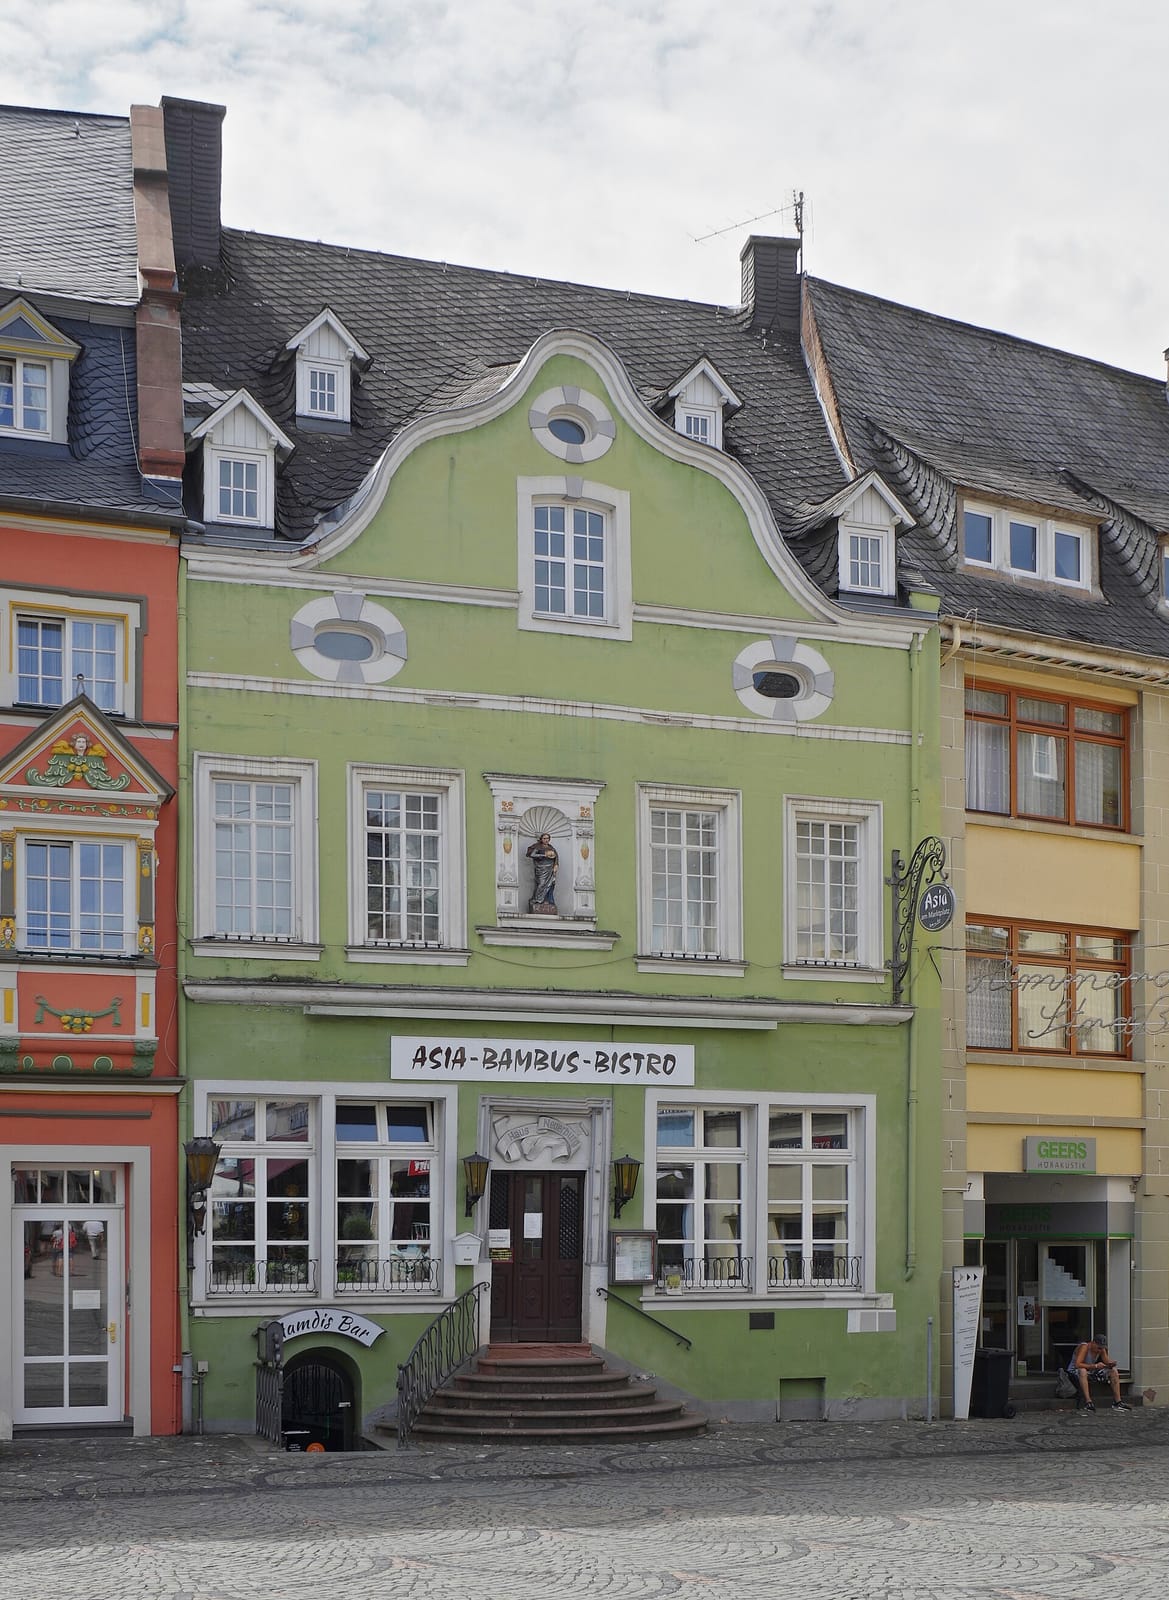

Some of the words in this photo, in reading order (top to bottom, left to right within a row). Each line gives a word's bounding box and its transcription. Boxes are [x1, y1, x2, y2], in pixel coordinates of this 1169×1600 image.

[925, 889, 948, 910] Asia
[411, 1045, 677, 1076] ASIA-BAMBUS-BISTRO
[507, 1127, 530, 1141] Haus
[1037, 1140, 1088, 1160] GEERS
[967, 1182, 973, 1192] 7
[338, 1315, 370, 1338] Bar
